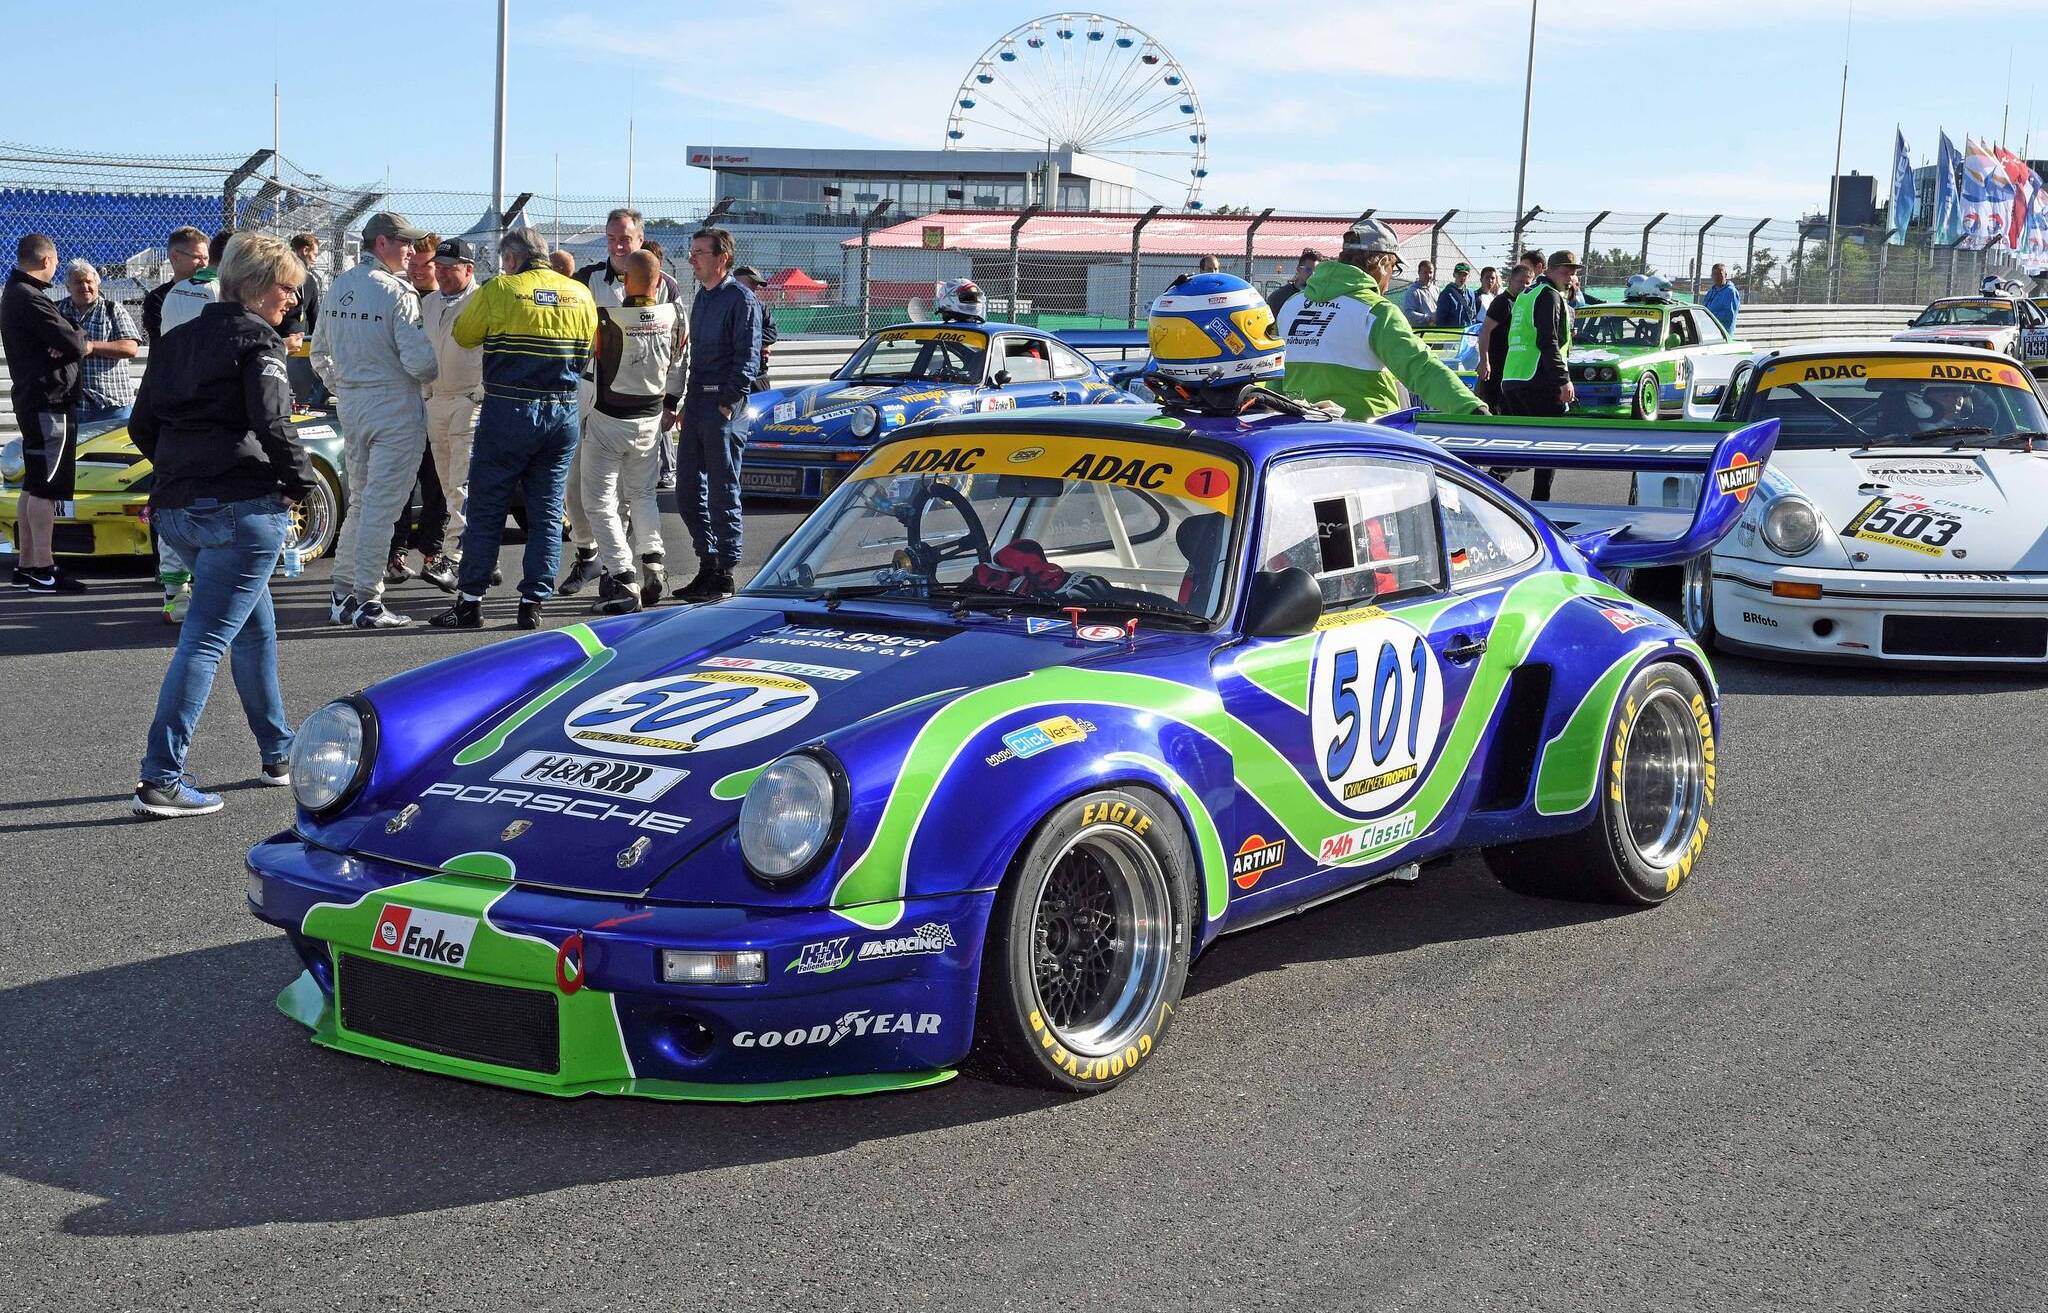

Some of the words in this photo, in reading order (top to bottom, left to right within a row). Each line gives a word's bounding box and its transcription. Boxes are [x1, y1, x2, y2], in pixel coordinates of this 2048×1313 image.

[725, 154, 750, 164] Sport
[1314, 300, 1341, 310] TOTAL
[1629, 309, 1655, 317] ADAC
[878, 331, 909, 342] ADAC
[932, 332, 966, 343] ADAC
[2025, 341, 2046, 357] 433
[1804, 364, 1868, 381] ADAC
[1931, 364, 1994, 382] ADAC
[763, 423, 824, 436] Wrangler
[888, 447, 986, 475] ADAC
[1061, 453, 1174, 489] ADAC
[742, 474, 794, 487] MOTALIN
[1198, 471, 1212, 495] 1
[1719, 465, 1758, 491] MARTINI
[1869, 468, 1985, 477] TANDLER
[1893, 492, 1926, 502] 24h
[1933, 499, 1995, 515] Classic
[1918, 508, 1961, 520] Enke
[1863, 507, 1962, 547] 503
[1858, 532, 1941, 556] youngtimer.de
[1742, 611, 1778, 628] BRfoto
[1089, 626, 1108, 637] E
[704, 656, 755, 668] 24h
[761, 662, 854, 681] Classic
[687, 671, 808, 691] youngtimer.de
[567, 680, 811, 744] 501
[1331, 635, 1427, 783] 501
[1610, 694, 1638, 801] EAGLE
[418, 782, 693, 835] PORSCHE
[1081, 801, 1153, 837] EAGLE
[1320, 834, 1354, 861] 24h
[1359, 815, 1415, 850] Classic
[401, 925, 465, 964] Enke
